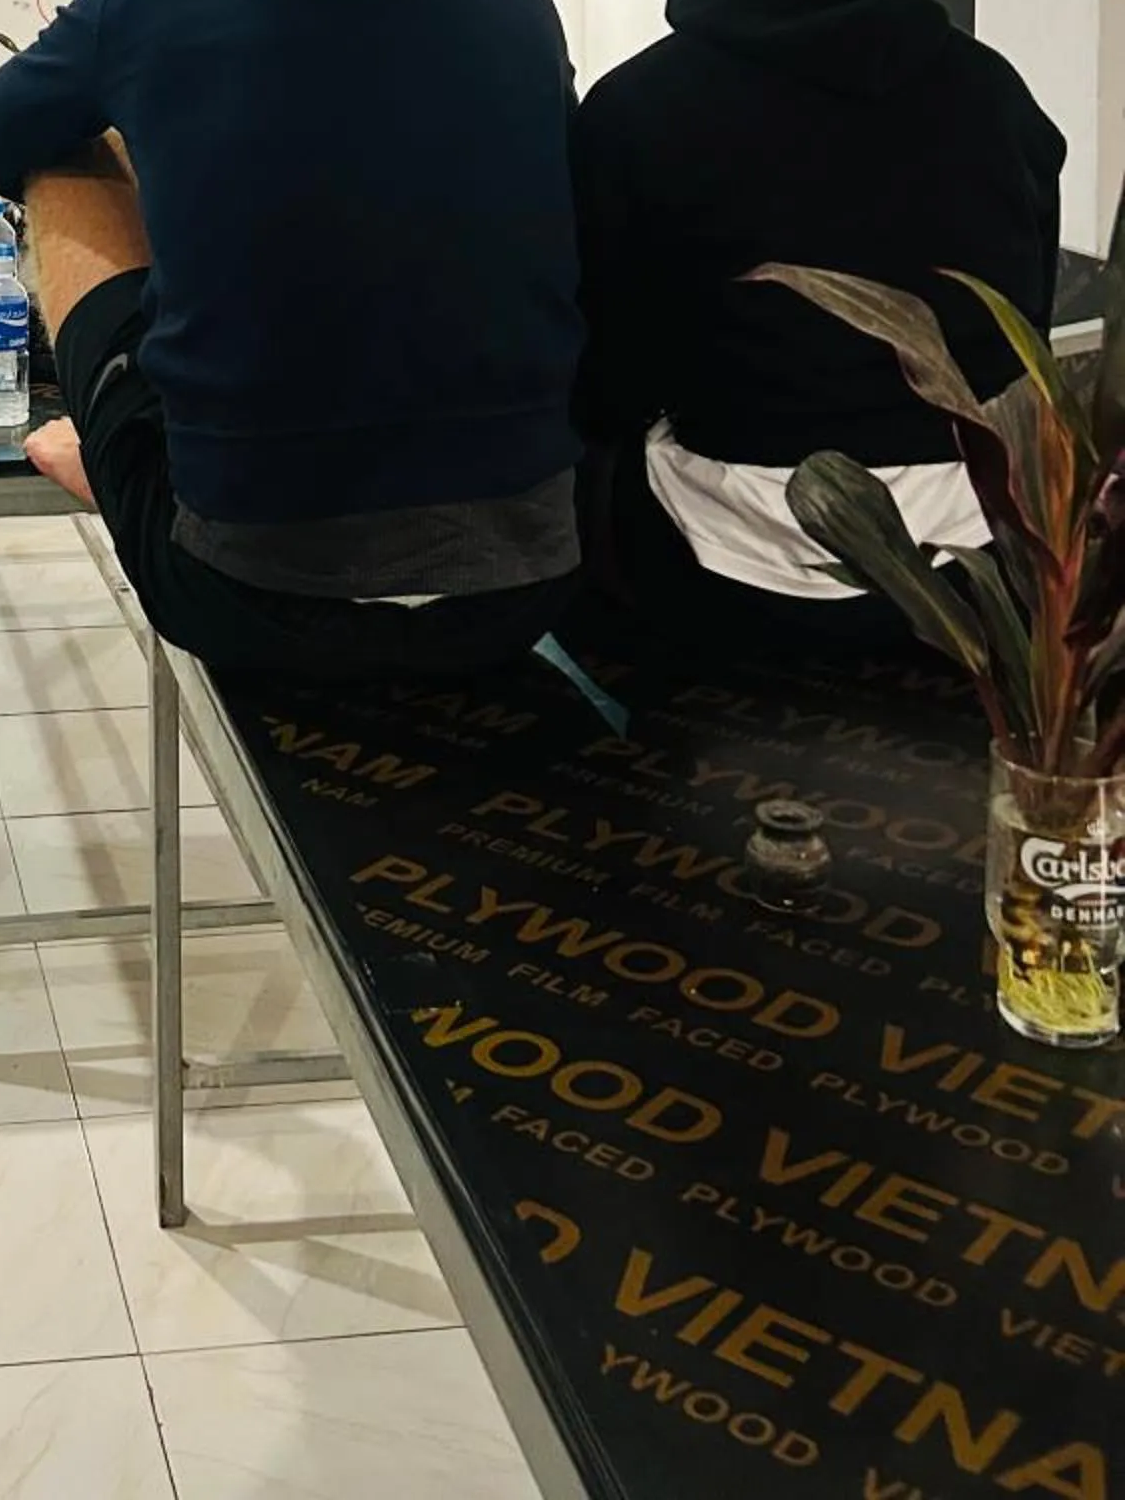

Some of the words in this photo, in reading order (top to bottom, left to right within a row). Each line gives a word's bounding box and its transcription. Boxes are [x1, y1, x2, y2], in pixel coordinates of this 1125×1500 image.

[261, 712, 441, 790] NAM
[299, 777, 380, 809] NAM
[347, 852, 842, 1040] PLYWOOD
[436, 821, 613, 886] PREMIUM
[628, 882, 726, 924] FILM
[743, 919, 893, 978] FACED
[353, 902, 492, 966] EMIUM
[506, 960, 611, 1010] FILM
[626, 1004, 786, 1073] FACED
[807, 1071, 1071, 1177] PLYWOOD
[487, 1102, 657, 1184] FACED
[674, 1180, 960, 1307] PLYWOOD
[598, 1342, 824, 1469] YWOOD
[614, 1244, 1111, 1500] VIETNA
